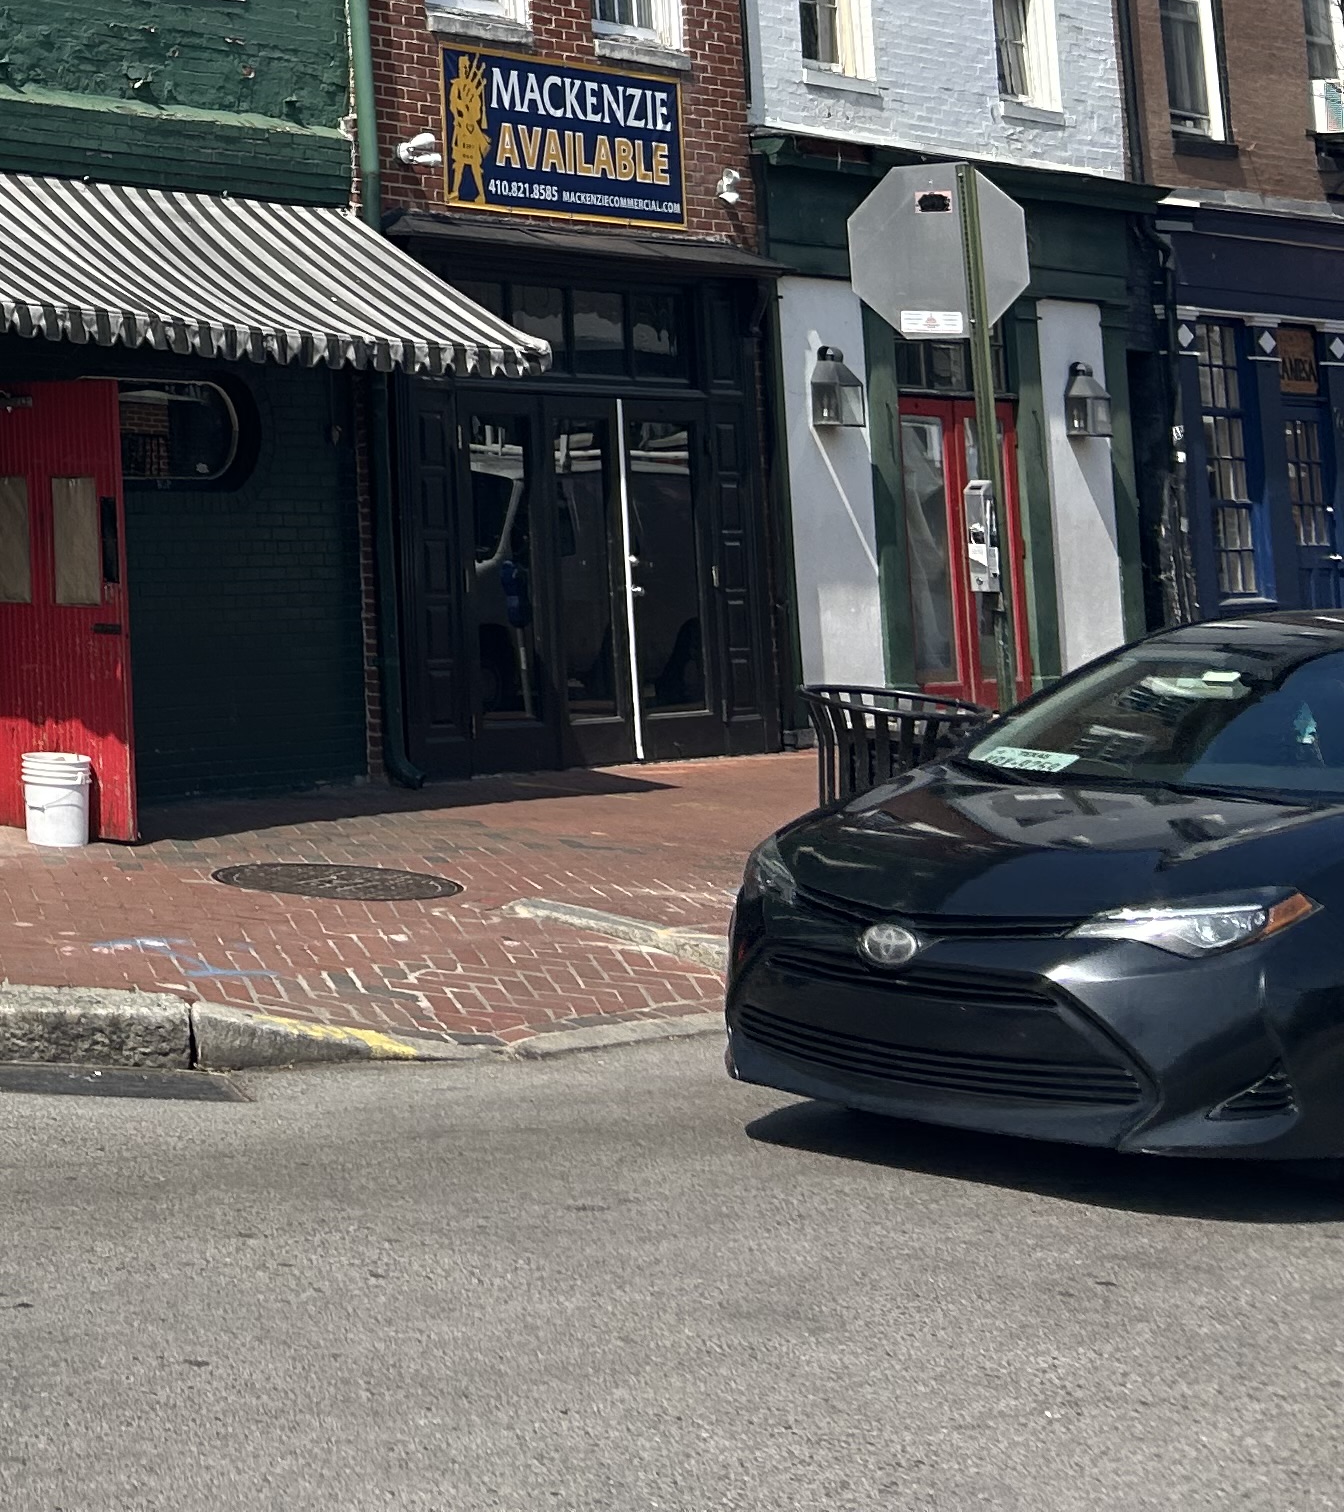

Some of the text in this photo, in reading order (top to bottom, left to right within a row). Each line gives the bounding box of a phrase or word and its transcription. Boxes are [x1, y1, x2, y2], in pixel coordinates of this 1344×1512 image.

[490, 67, 672, 132] MACKENZIE
[495, 123, 670, 186] AVAILABLE
[488, 178, 681, 214] 410.821.8585 MACKENZIECOMMERCIAL.COM
